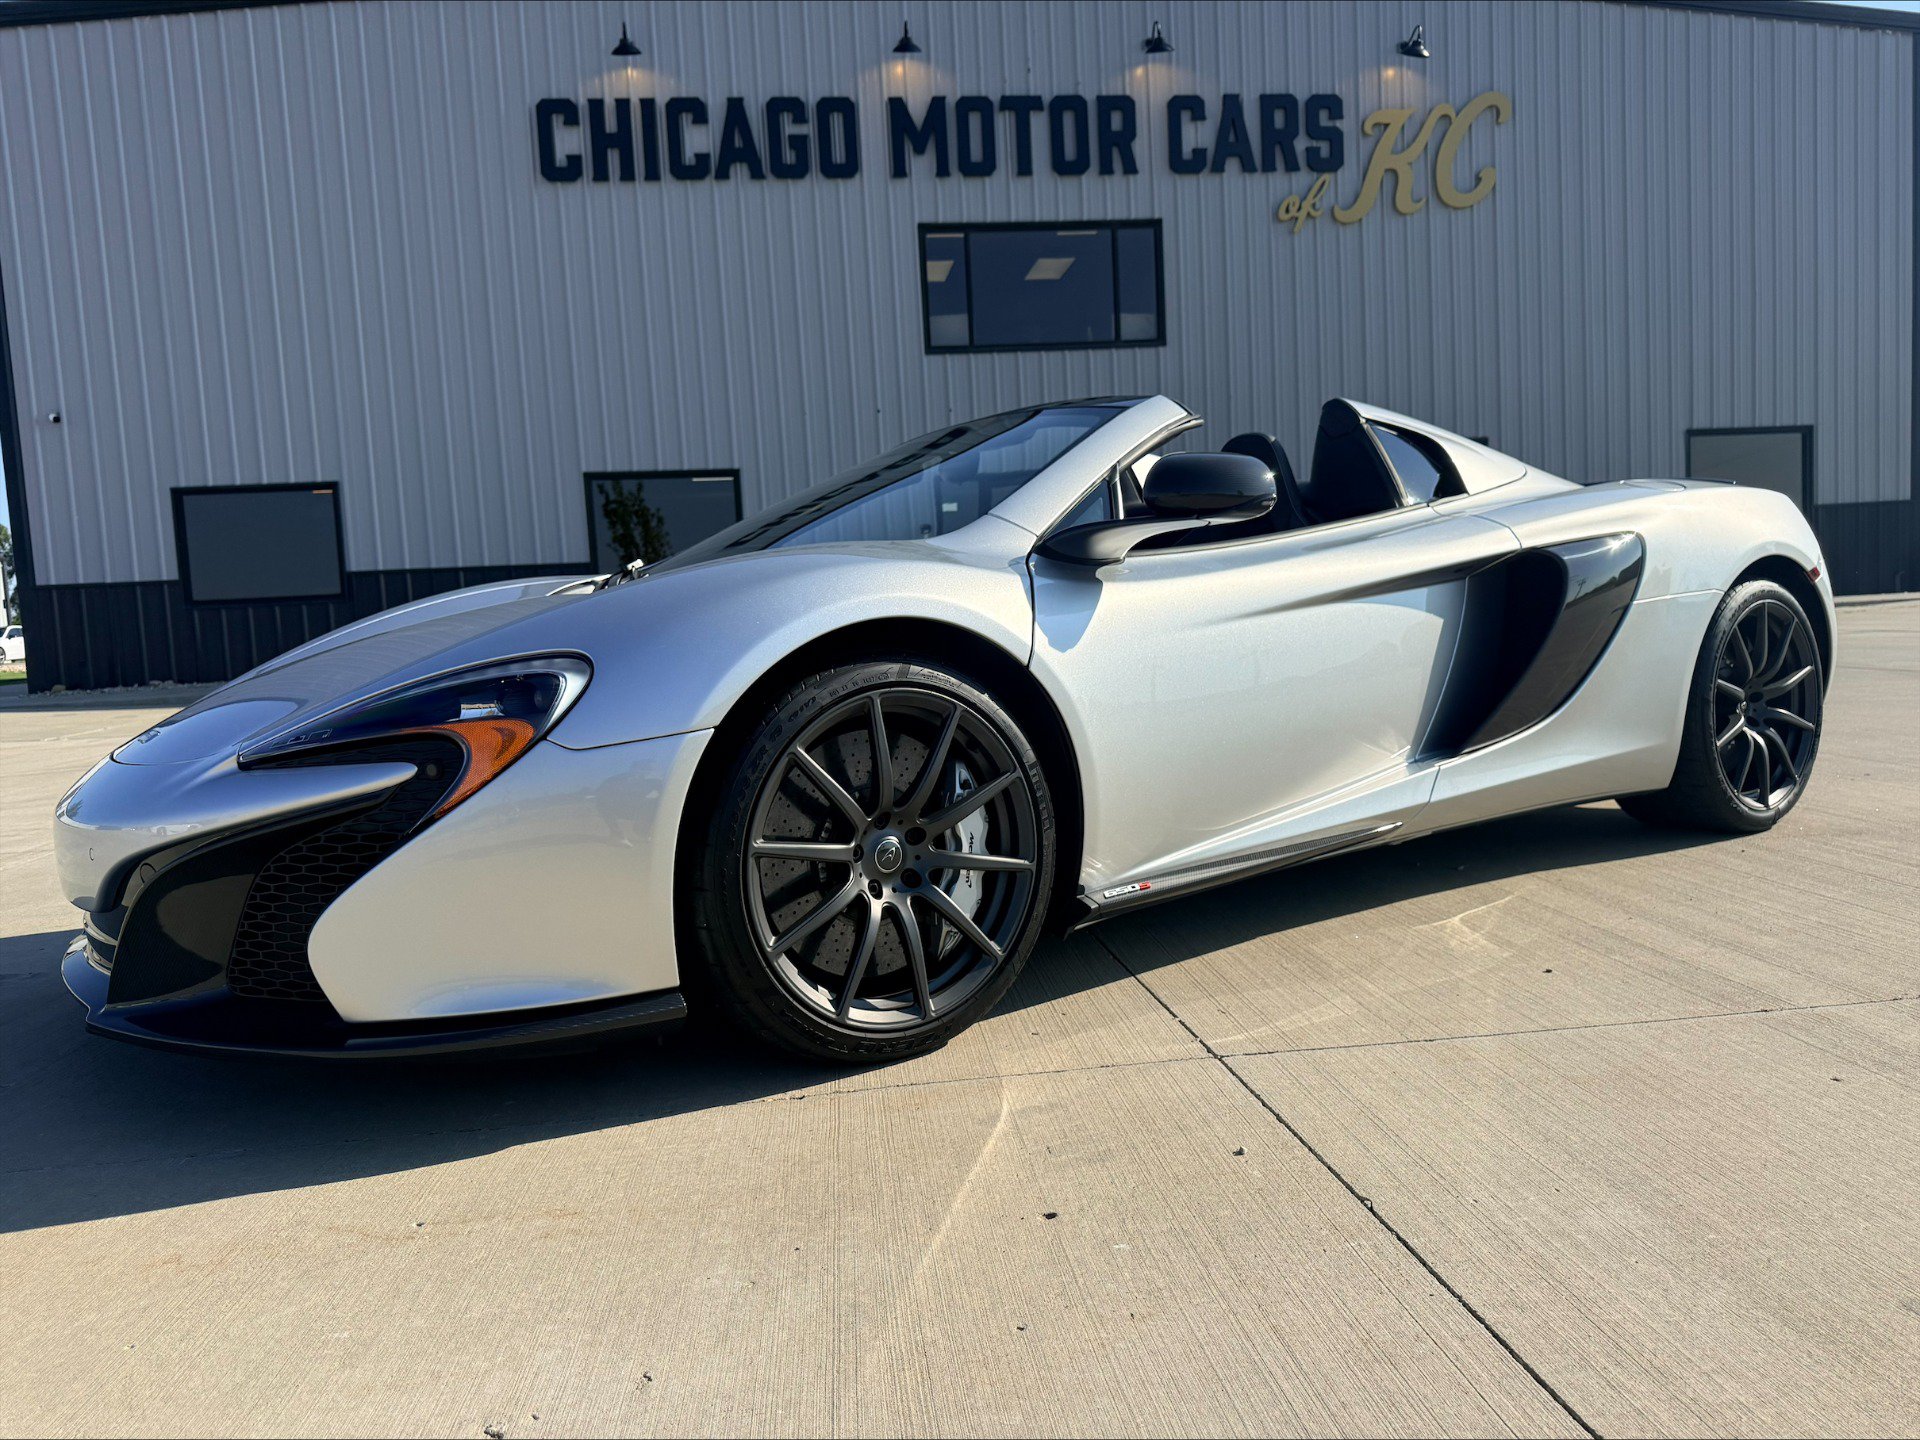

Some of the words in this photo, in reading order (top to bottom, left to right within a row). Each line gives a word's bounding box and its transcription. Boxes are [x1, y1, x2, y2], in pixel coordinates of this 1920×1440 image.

[535, 96, 859, 182] CHICAGO
[887, 94, 1139, 178] MOTOR
[1167, 93, 1344, 174] CARS
[1277, 173, 1330, 235] of
[1332, 90, 1512, 225] KC
